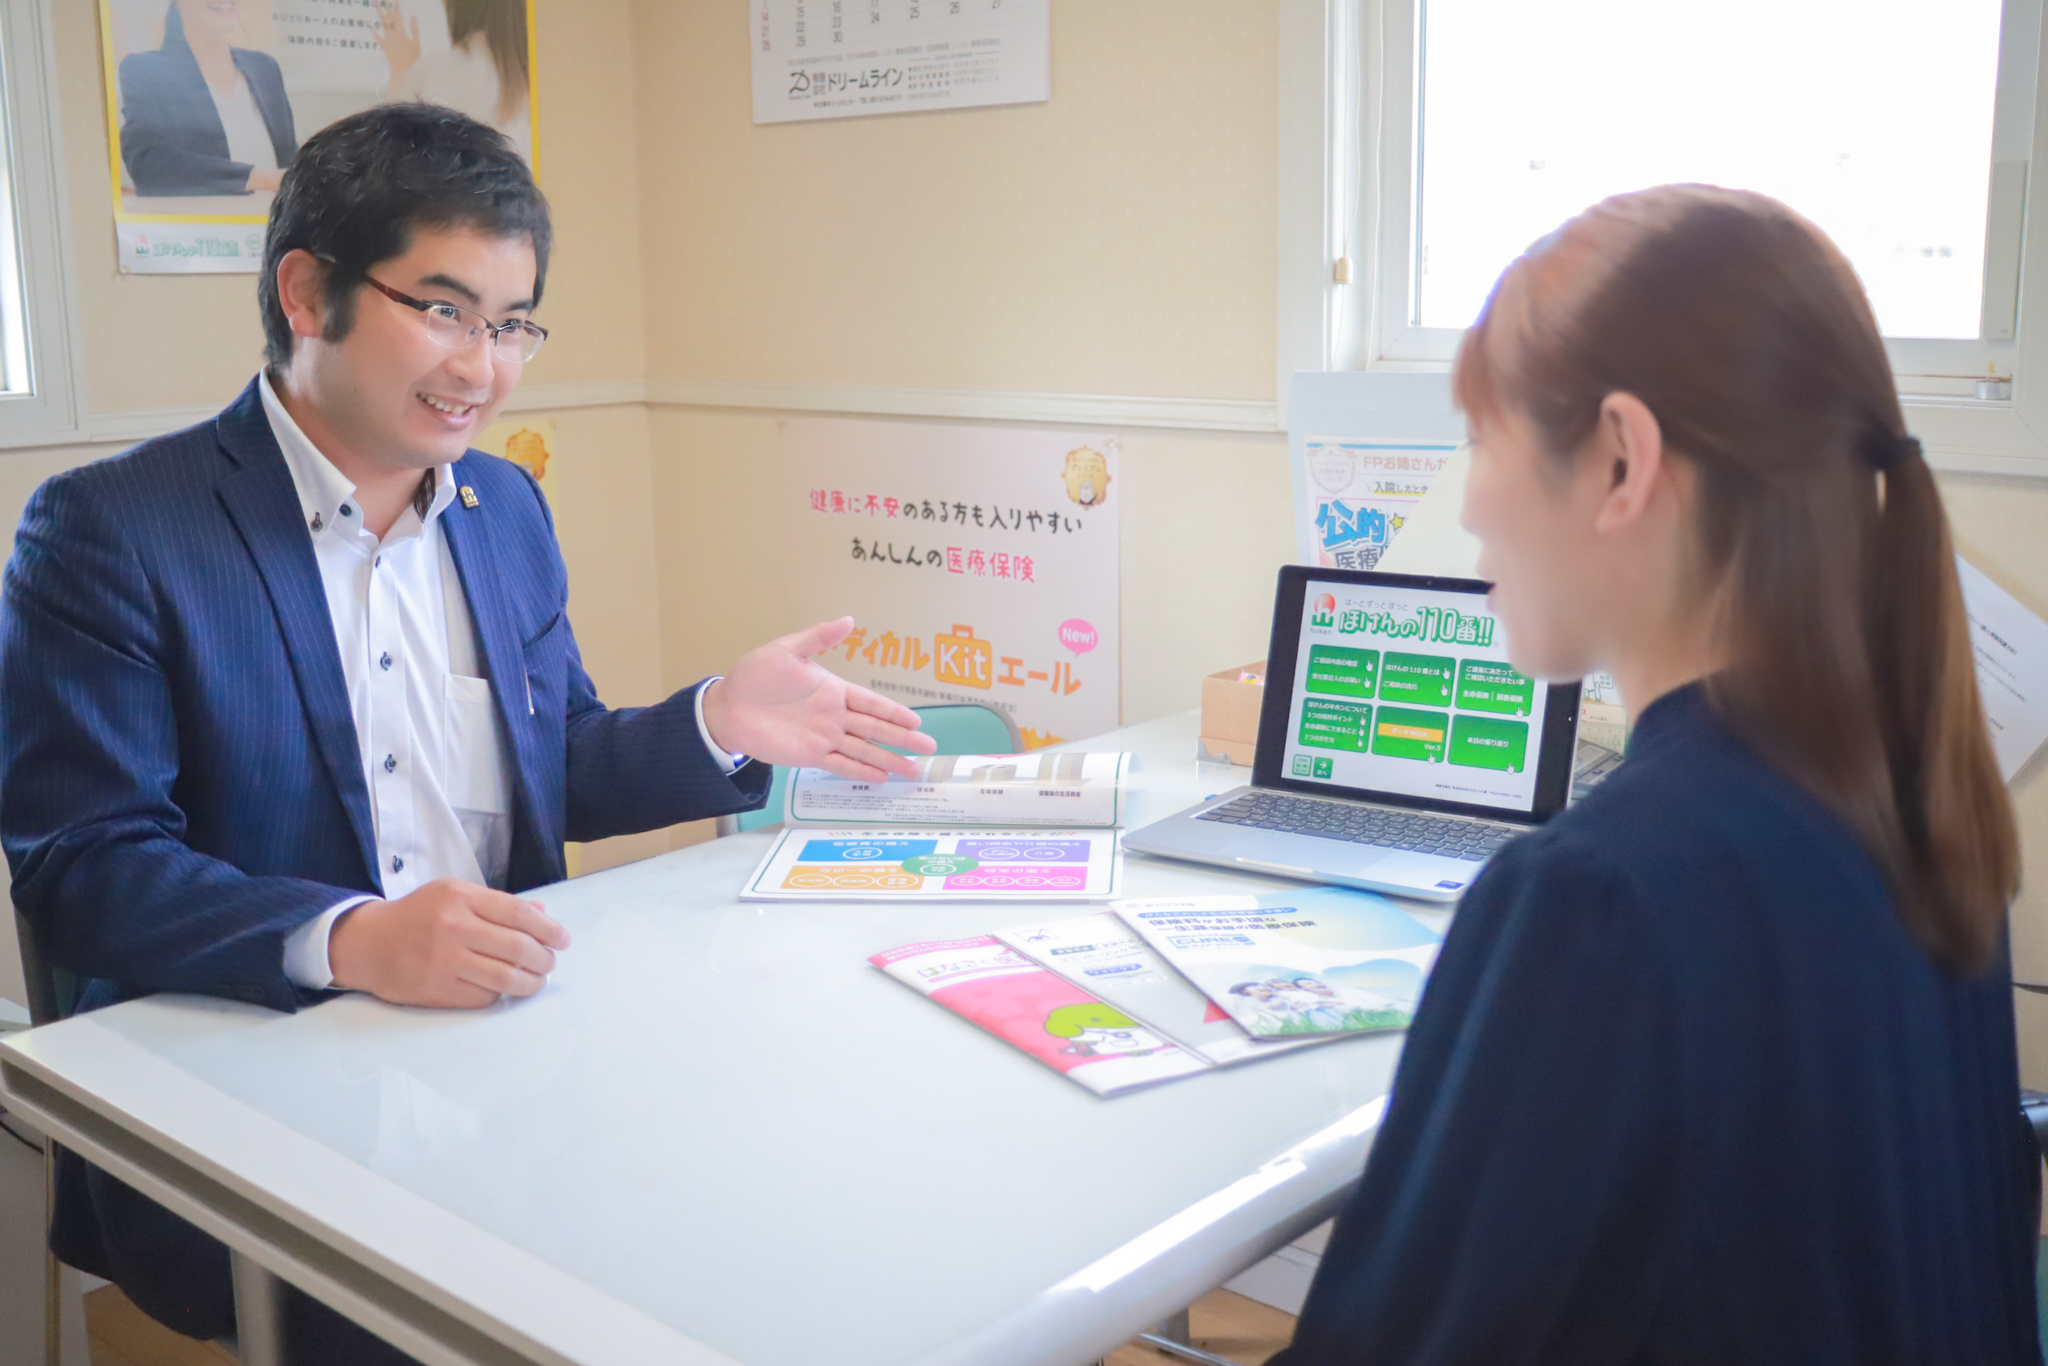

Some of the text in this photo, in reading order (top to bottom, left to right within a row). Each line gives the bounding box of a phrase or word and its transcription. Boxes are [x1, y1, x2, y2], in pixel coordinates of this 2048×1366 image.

[828, 66, 903, 93] ドリームライン
[809, 488, 1083, 534] 健康に不安のある方も入りやすい
[1315, 499, 1386, 548] 公的
[851, 537, 1035, 583] あんしんの医療保険
[1062, 627, 1096, 645] New!
[1310, 627, 1332, 636] hoken
[1338, 605, 1494, 647] ほけんの110番!!
[940, 643, 987, 681] Kit
[998, 656, 1082, 697] エール
[1466, 736, 1509, 748] 本日の振り返り
